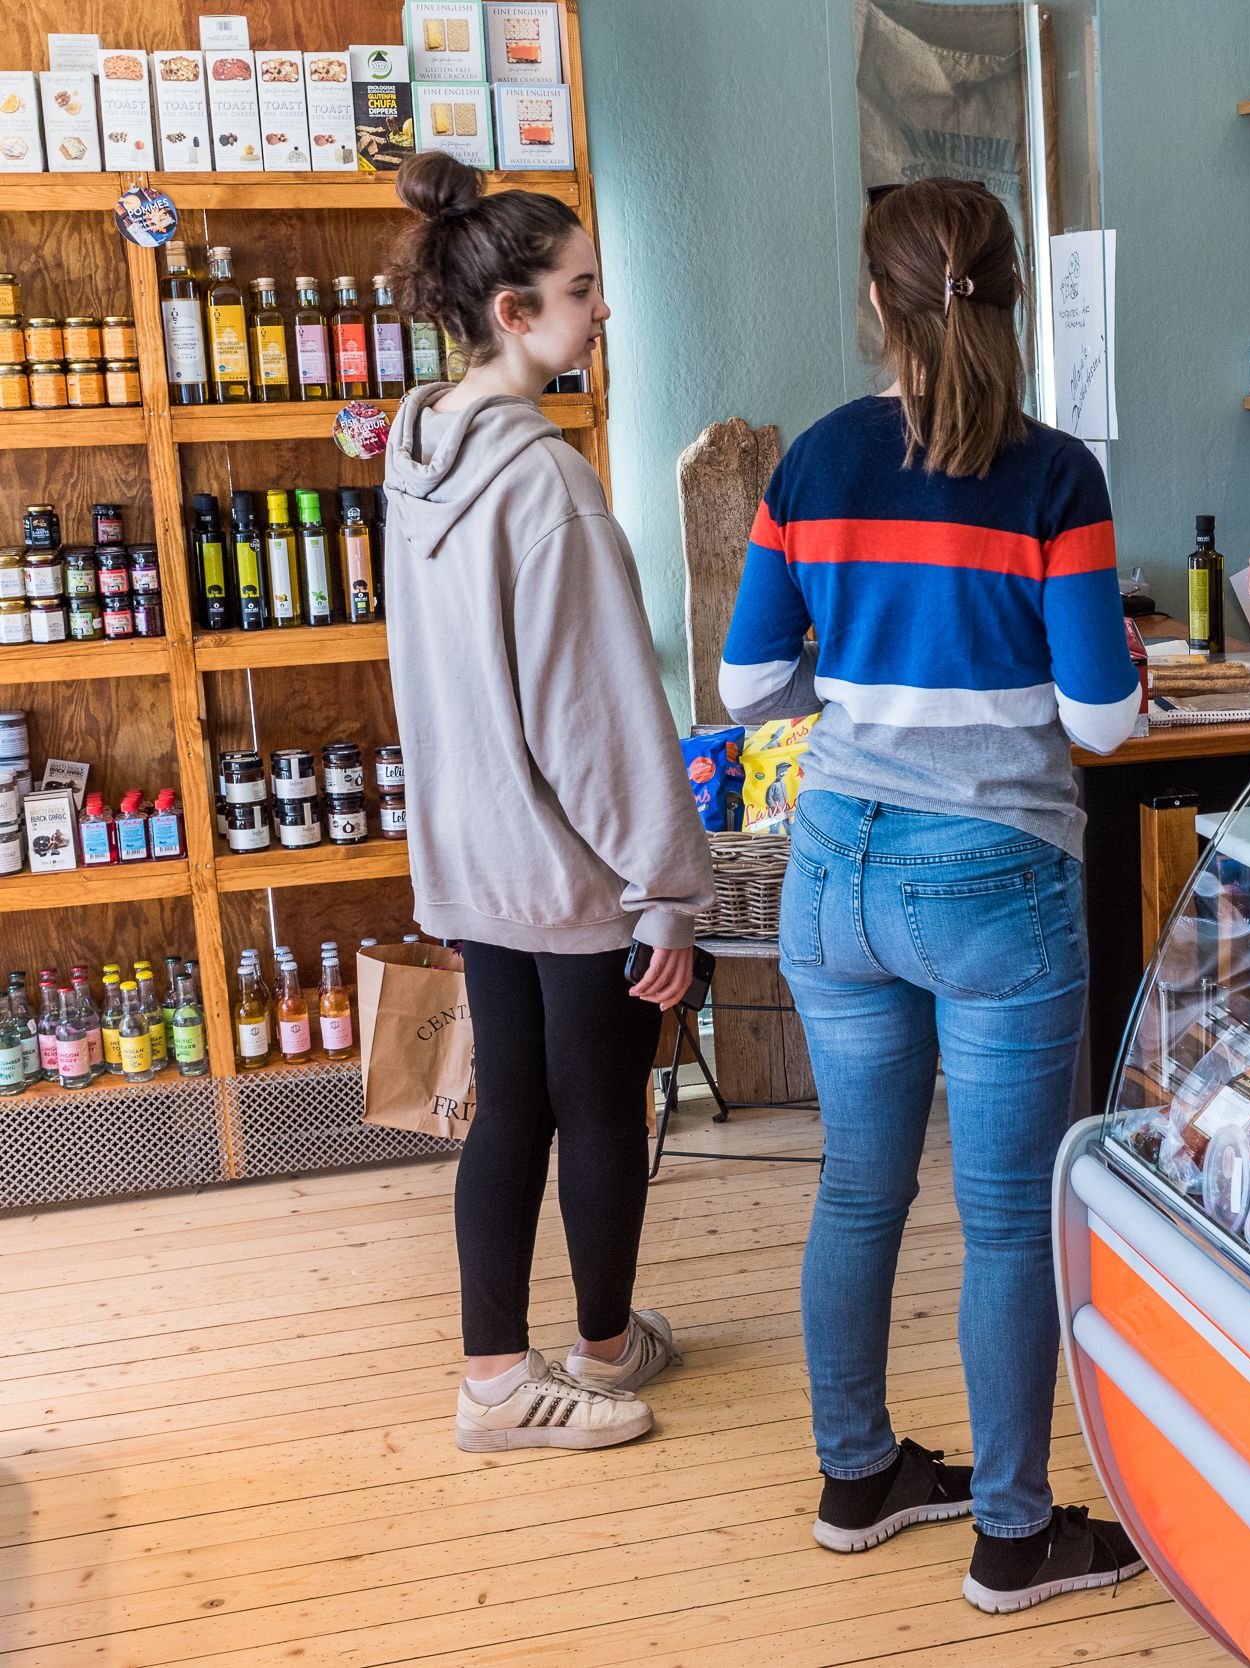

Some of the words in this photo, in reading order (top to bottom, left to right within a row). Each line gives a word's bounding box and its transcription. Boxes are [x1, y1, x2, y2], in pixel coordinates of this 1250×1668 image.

[436, 4, 473, 12] ENGLISH
[506, 89, 525, 97] FINE
[105, 100, 146, 111] TOAST
[163, 101, 204, 112] TOAST
[214, 101, 255, 111] TOAST
[263, 101, 303, 111] TOAST
[368, 99, 397, 109] CHUFA
[311, 105, 352, 114] TOAST
[127, 198, 170, 218] POMMES
[30, 815, 47, 823] BLACK
[48, 813, 67, 821] GARLIC
